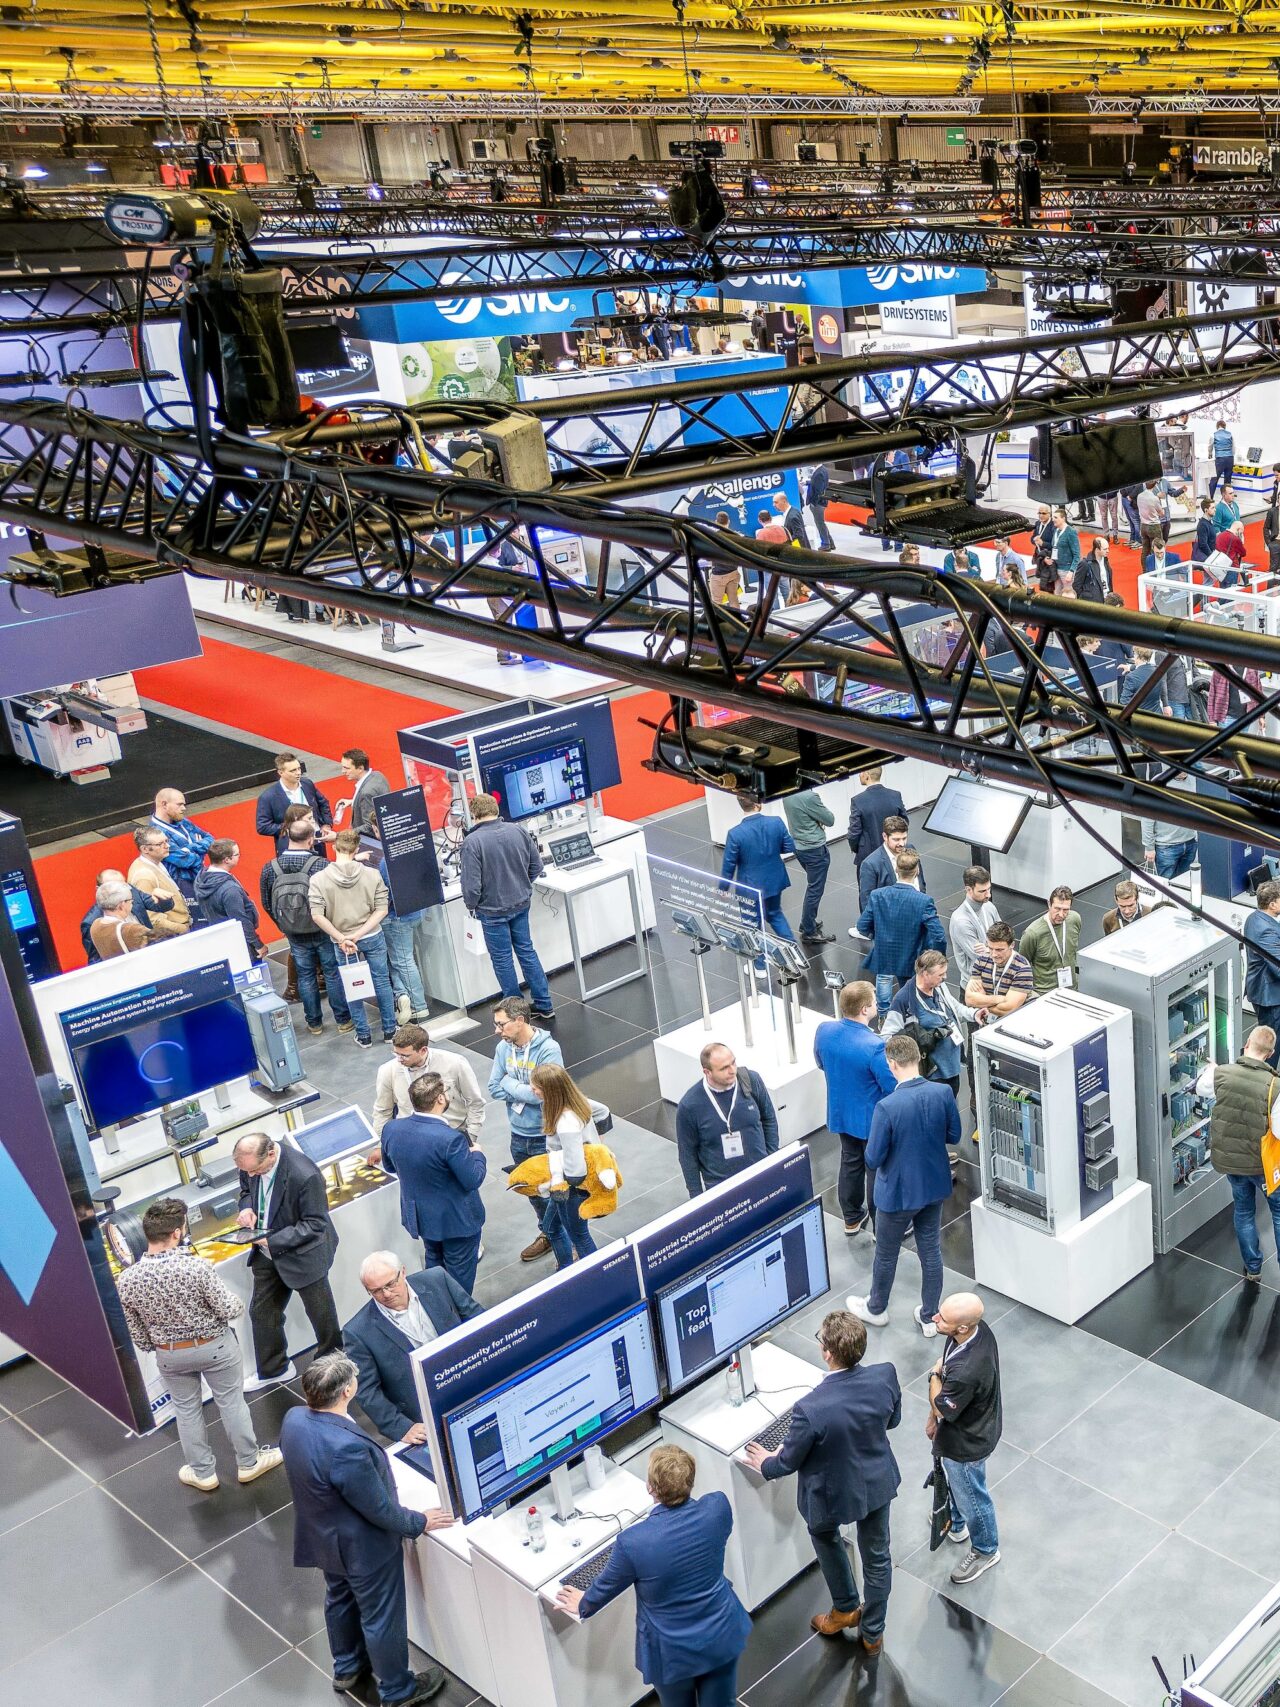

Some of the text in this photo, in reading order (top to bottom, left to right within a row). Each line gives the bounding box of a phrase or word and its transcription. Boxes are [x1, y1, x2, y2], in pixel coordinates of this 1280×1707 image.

[883, 306, 948, 323] DRIVESYSTEMS
[199, 963, 225, 975] SIEMENS
[70, 988, 184, 1030] Machine Automation Engineering
[72, 1026, 90, 1037] Energy
[91, 1019, 112, 1031] efficient
[112, 1014, 126, 1024] drive
[126, 1008, 147, 1020] systems
[155, 1001, 166, 1011] any
[165, 991, 194, 1007] application
[783, 1152, 806, 1169] SIEMENS
[647, 1198, 751, 1262] Industrial Cybersecurity Services
[648, 1261, 658, 1270] NIS
[711, 1222, 724, 1235] plant
[729, 1210, 749, 1223] network
[753, 1196, 769, 1210] system
[769, 1185, 788, 1201] security
[602, 1252, 630, 1271] SIEMENS
[685, 1303, 708, 1322] Top
[434, 1318, 538, 1381] Cybersecurity for Industry
[435, 1371, 462, 1390] Security
[462, 1360, 482, 1375] where
[488, 1344, 512, 1361] matters
[512, 1334, 528, 1346] most
